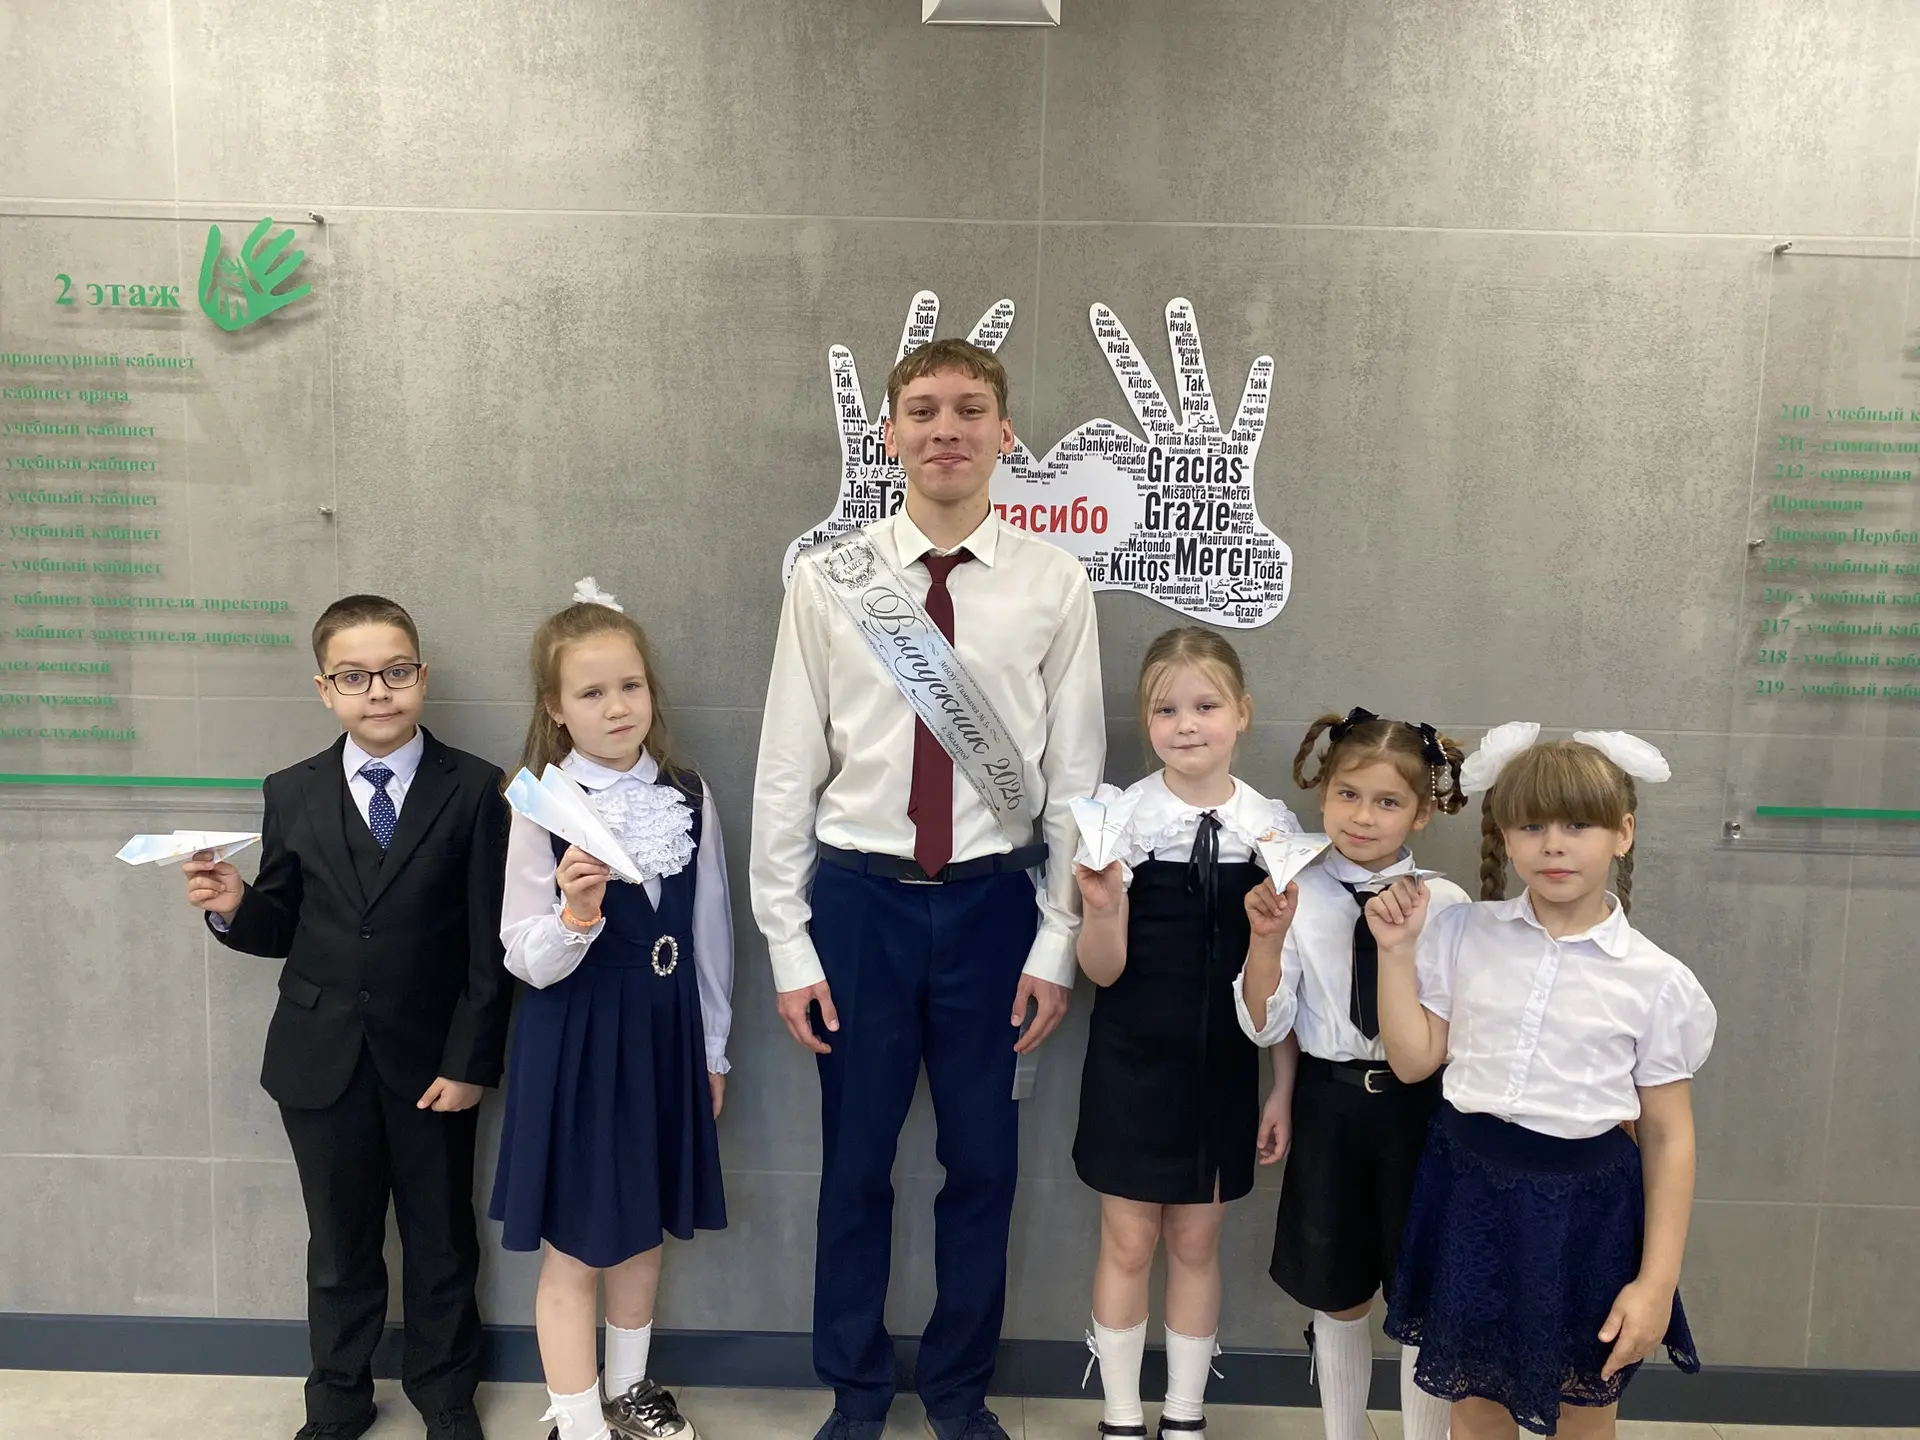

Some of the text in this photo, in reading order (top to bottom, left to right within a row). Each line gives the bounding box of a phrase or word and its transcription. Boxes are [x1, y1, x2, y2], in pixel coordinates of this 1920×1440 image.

[54, 274, 181, 308] 2 этаж
[915, 312, 934, 325] Toda
[1098, 309, 1109, 317] Toda
[1170, 310, 1186, 319] Danke
[1096, 318, 1115, 326] Gracias
[1170, 320, 1192, 332] Hvala
[909, 327, 930, 337] Danke
[979, 328, 1003, 339] Gracias
[1098, 327, 1121, 337] Dankie
[1107, 341, 1130, 353] Hvala
[1178, 347, 1200, 355] Matondo
[1, 353, 195, 369] процедурный кабинет
[1115, 359, 1138, 369] Sagolun
[1180, 355, 1199, 366] Takk
[836, 373, 852, 388] Tak
[1128, 376, 1152, 388] Kiitos
[1185, 375, 1205, 391] Tak
[1250, 378, 1267, 389] Takk
[3, 385, 129, 405] кабинет врача
[837, 392, 855, 404] Toda
[1134, 390, 1160, 400] Спасибо
[1183, 396, 1209, 411] Hvala
[1243, 405, 1264, 415] Sagolun
[841, 405, 862, 418] Takk
[1142, 406, 1167, 418] Mercé
[1781, 404, 1904, 425] 210 учебный
[4, 421, 156, 437] учебный кабинет
[1202, 425, 1220, 433] Dankie
[1239, 417, 1264, 428] Obrigado
[1155, 433, 1206, 446] Terima Kasih
[1232, 429, 1256, 441] Danke
[848, 444, 860, 455] Tak
[1061, 441, 1078, 451] Kiitos
[1080, 436, 1132, 455] Dankjewel
[1133, 443, 1147, 453] Toda
[1221, 441, 1248, 455] Danke
[1777, 435, 1804, 451] 211
[1002, 454, 1029, 465] Rahmat
[1056, 451, 1083, 461] Efharisto
[1112, 453, 1146, 465] Спасибо
[6, 455, 157, 472] учебный кабинет
[1147, 447, 1243, 484] Gracias
[1028, 470, 1057, 480] Dankjewel
[1775, 464, 1912, 484] 212 серверная
[849, 480, 870, 498] Tak
[893, 480, 907, 489] Takk
[8, 490, 157, 506] учебный кабинет
[1162, 484, 1206, 500] Misaotra
[1222, 486, 1250, 500] Merci
[842, 500, 877, 518] Hvala
[994, 495, 1108, 534] пасибо
[1145, 491, 1231, 531] Grazie
[10, 524, 160, 541] учебный кабинет
[1231, 522, 1254, 534] Merci
[1128, 537, 1171, 552] Matondo
[1200, 532, 1243, 545] Mauruuru
[1252, 538, 1275, 546] Rahmat
[838, 549, 854, 565] 11
[1145, 552, 1176, 560] Faleminderit
[1174, 537, 1252, 577] Merci
[1252, 547, 1280, 559] Dankie
[12, 558, 162, 575] учебный кабинет
[1110, 552, 1170, 582] Kiitos
[1253, 560, 1283, 579] Toda
[1812, 558, 1889, 575] учебный
[1243, 577, 1254, 586] Tak
[1263, 580, 1284, 591] Merci
[1151, 582, 1201, 595] Faleminderit
[14, 591, 289, 614] кабинет заместителя директора
[1264, 592, 1284, 601] Merci
[1763, 588, 1886, 606] 216 учебный
[1235, 604, 1263, 617] Grazie
[1760, 619, 1790, 633] 217
[1806, 621, 1882, 637] учебный
[16, 625, 290, 647] кабинет заместителя директора
[1758, 650, 1879, 668] 218 учебный
[37, 660, 111, 674] женский
[938, 660, 960, 682] МБОУ
[1756, 680, 1876, 698] 219 учебный
[39, 692, 113, 709] мужской
[860, 586, 1025, 811] Выпускник 2026
[40, 725, 137, 740] служебный
